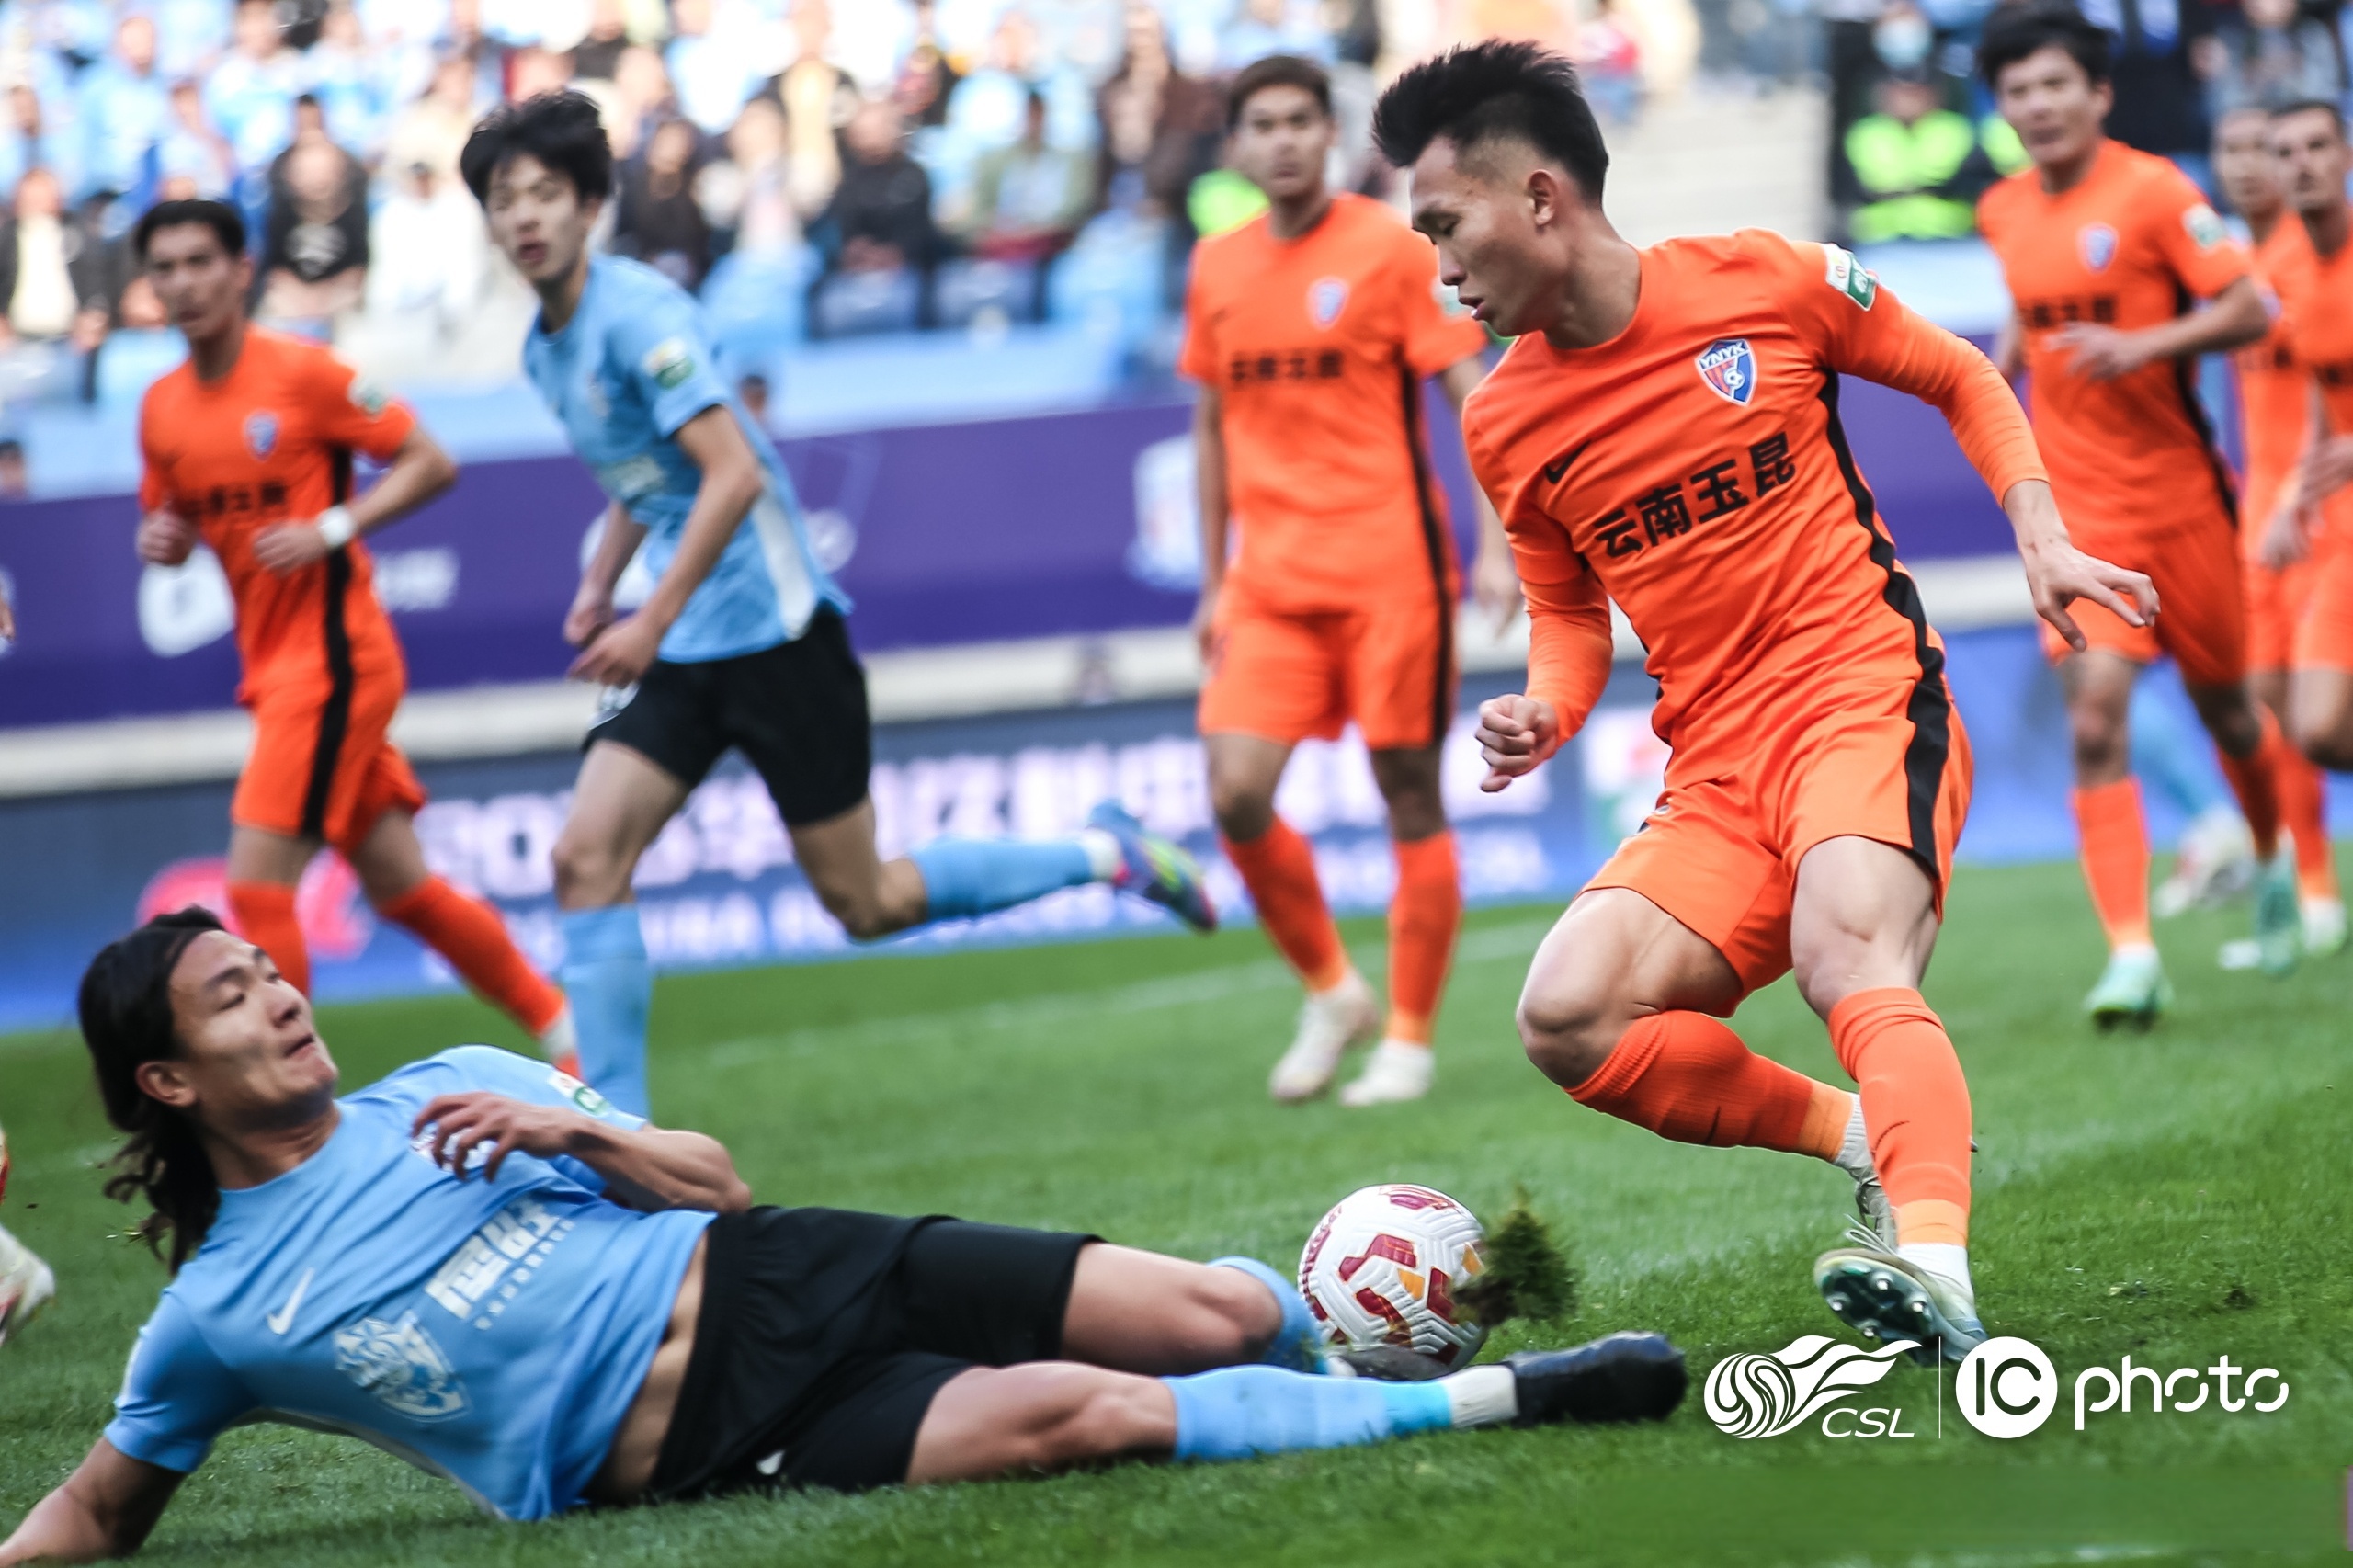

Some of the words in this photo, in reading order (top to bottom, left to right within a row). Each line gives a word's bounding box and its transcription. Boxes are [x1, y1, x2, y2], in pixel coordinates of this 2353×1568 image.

[1699, 342, 1746, 369] YNYK
[1593, 431, 1796, 559] 云南玉昆
